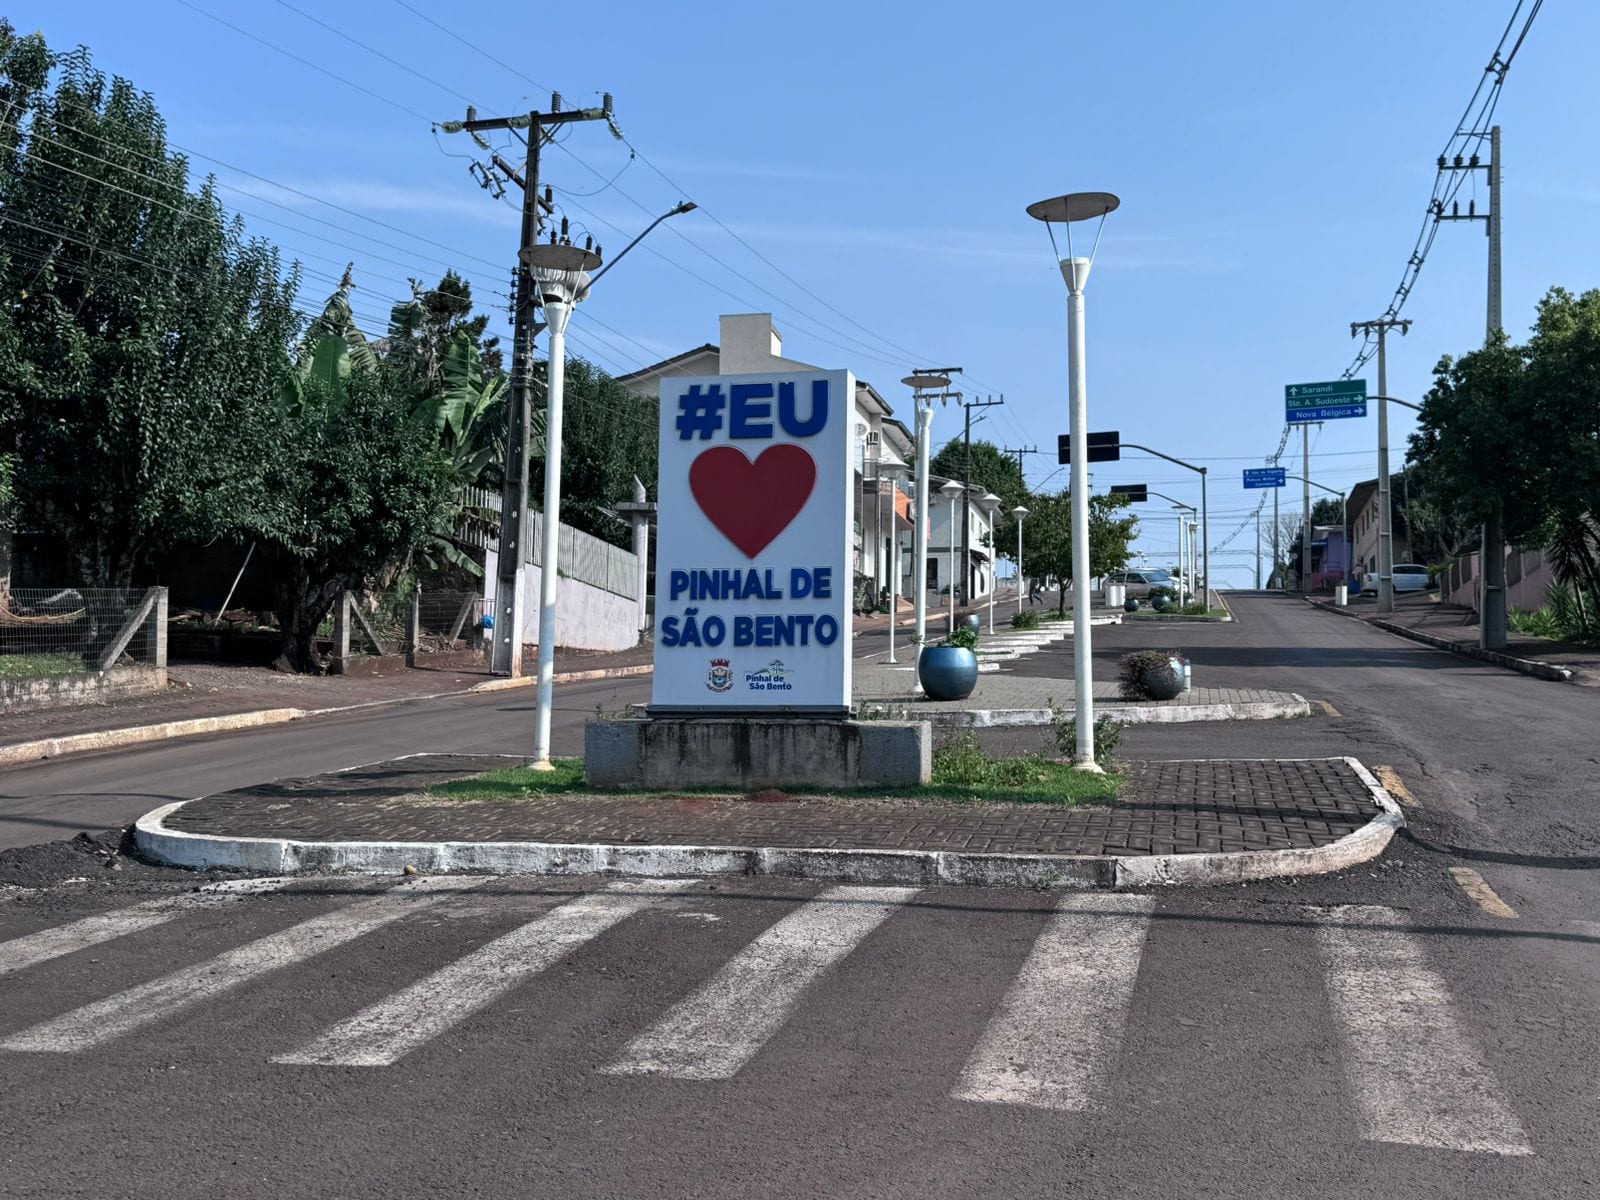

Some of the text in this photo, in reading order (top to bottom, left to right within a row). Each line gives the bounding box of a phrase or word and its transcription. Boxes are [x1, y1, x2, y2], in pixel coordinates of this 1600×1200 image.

[1302, 385, 1333, 394] Sarandi
[1315, 397, 1351, 406] Sudoeste
[676, 380, 829, 440] #EU
[1320, 408, 1352, 418] Bélgica
[670, 567, 832, 601] PINHAL DE
[661, 606, 838, 647] SÃO BENTO
[745, 674, 784, 682] Pinhal de
